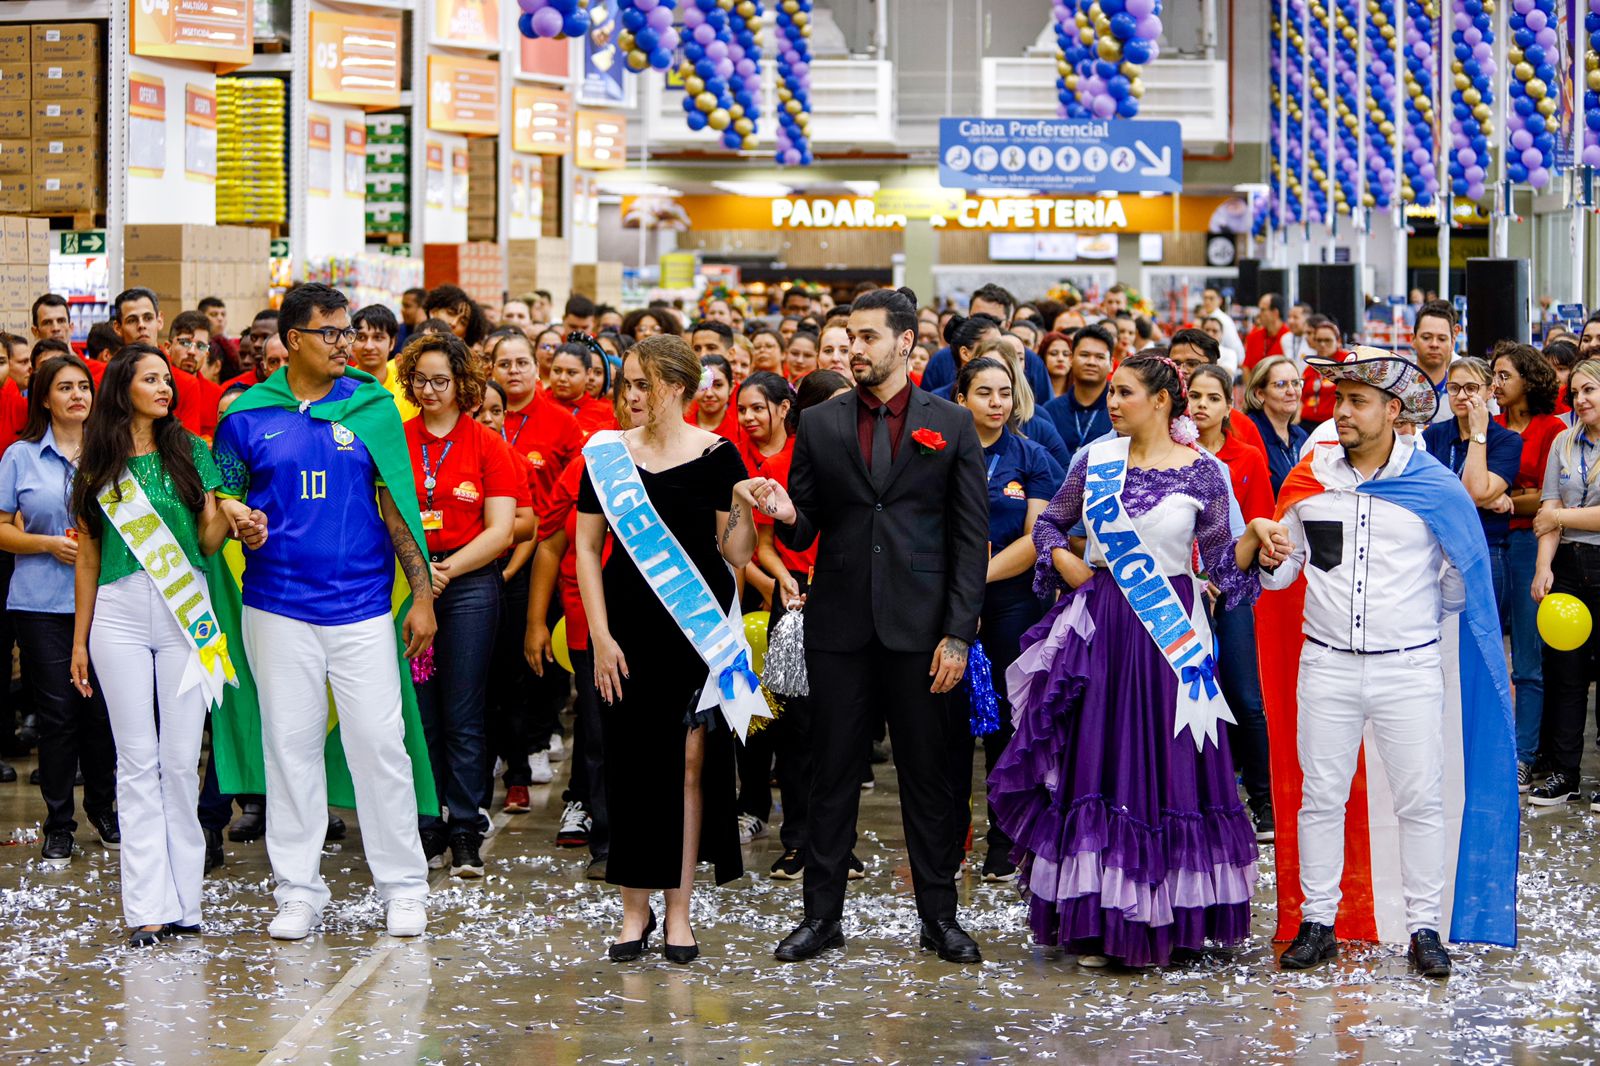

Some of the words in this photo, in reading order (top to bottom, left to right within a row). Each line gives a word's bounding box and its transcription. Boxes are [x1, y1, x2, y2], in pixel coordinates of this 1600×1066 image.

[317, 42, 338, 70] 05
[139, 85, 158, 105] OFERTA
[959, 121, 1005, 137] Caixa
[1009, 121, 1109, 138] Preferencial
[958, 199, 1127, 228] CAFETERIA
[300, 470, 327, 500] 10
[97, 478, 204, 630] RASIL
[582, 441, 723, 646] ARGENTINA
[1085, 459, 1192, 650] PARAGUAI
